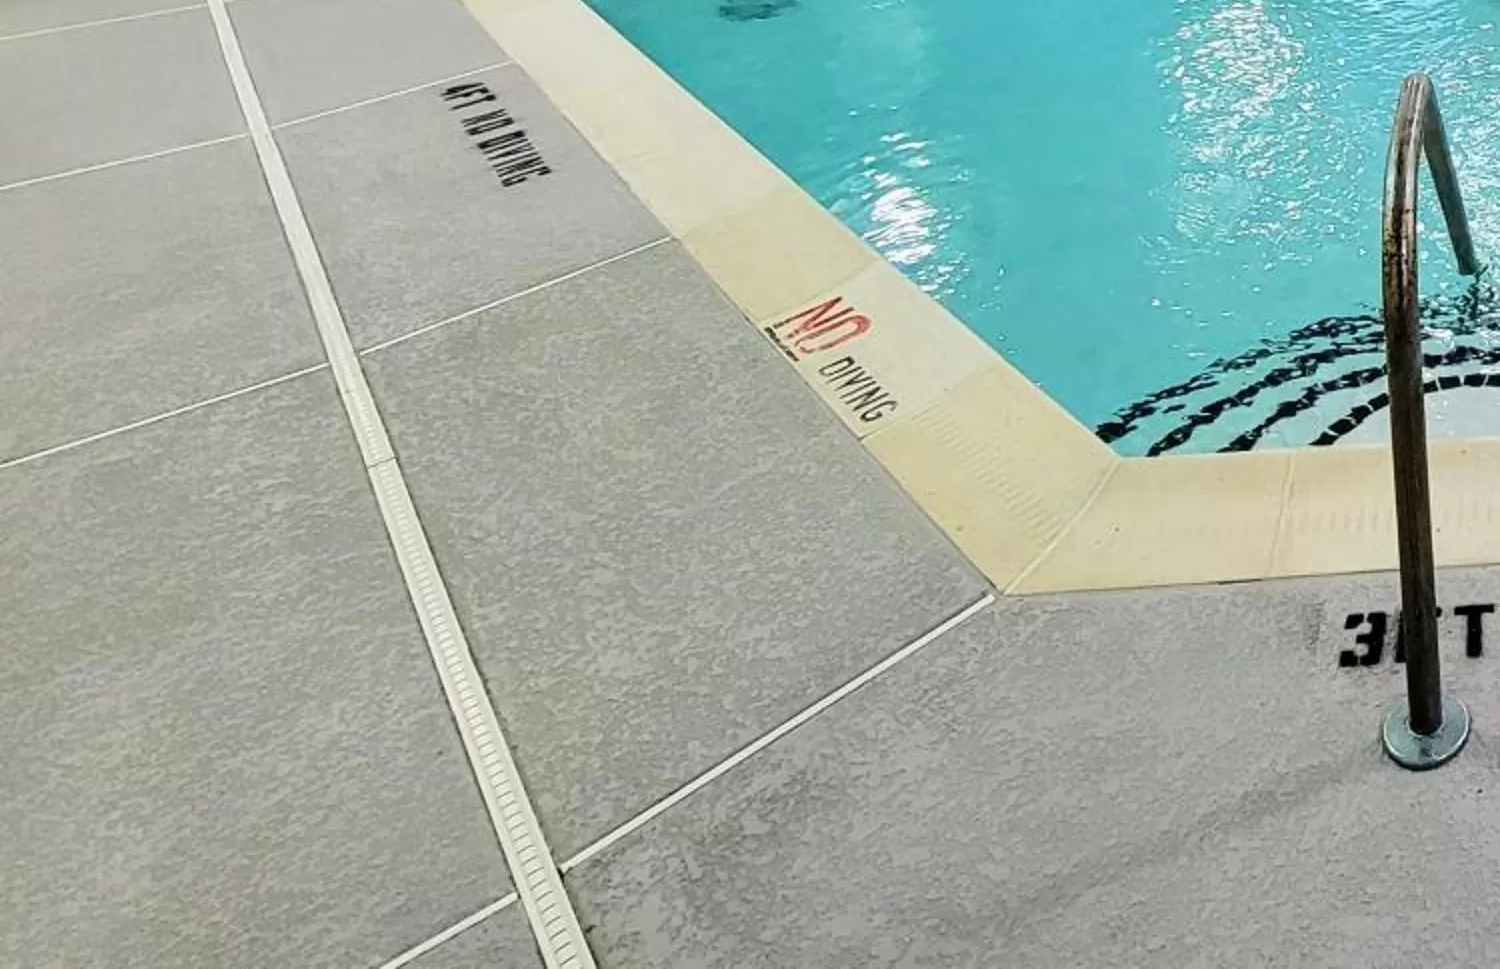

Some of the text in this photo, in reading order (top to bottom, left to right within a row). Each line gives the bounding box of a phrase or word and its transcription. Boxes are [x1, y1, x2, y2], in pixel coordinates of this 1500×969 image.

[477, 130, 552, 188] DIVING
[771, 296, 870, 354] NO
[818, 355, 897, 422] DIVING
[1339, 603, 1495, 667] 3T
